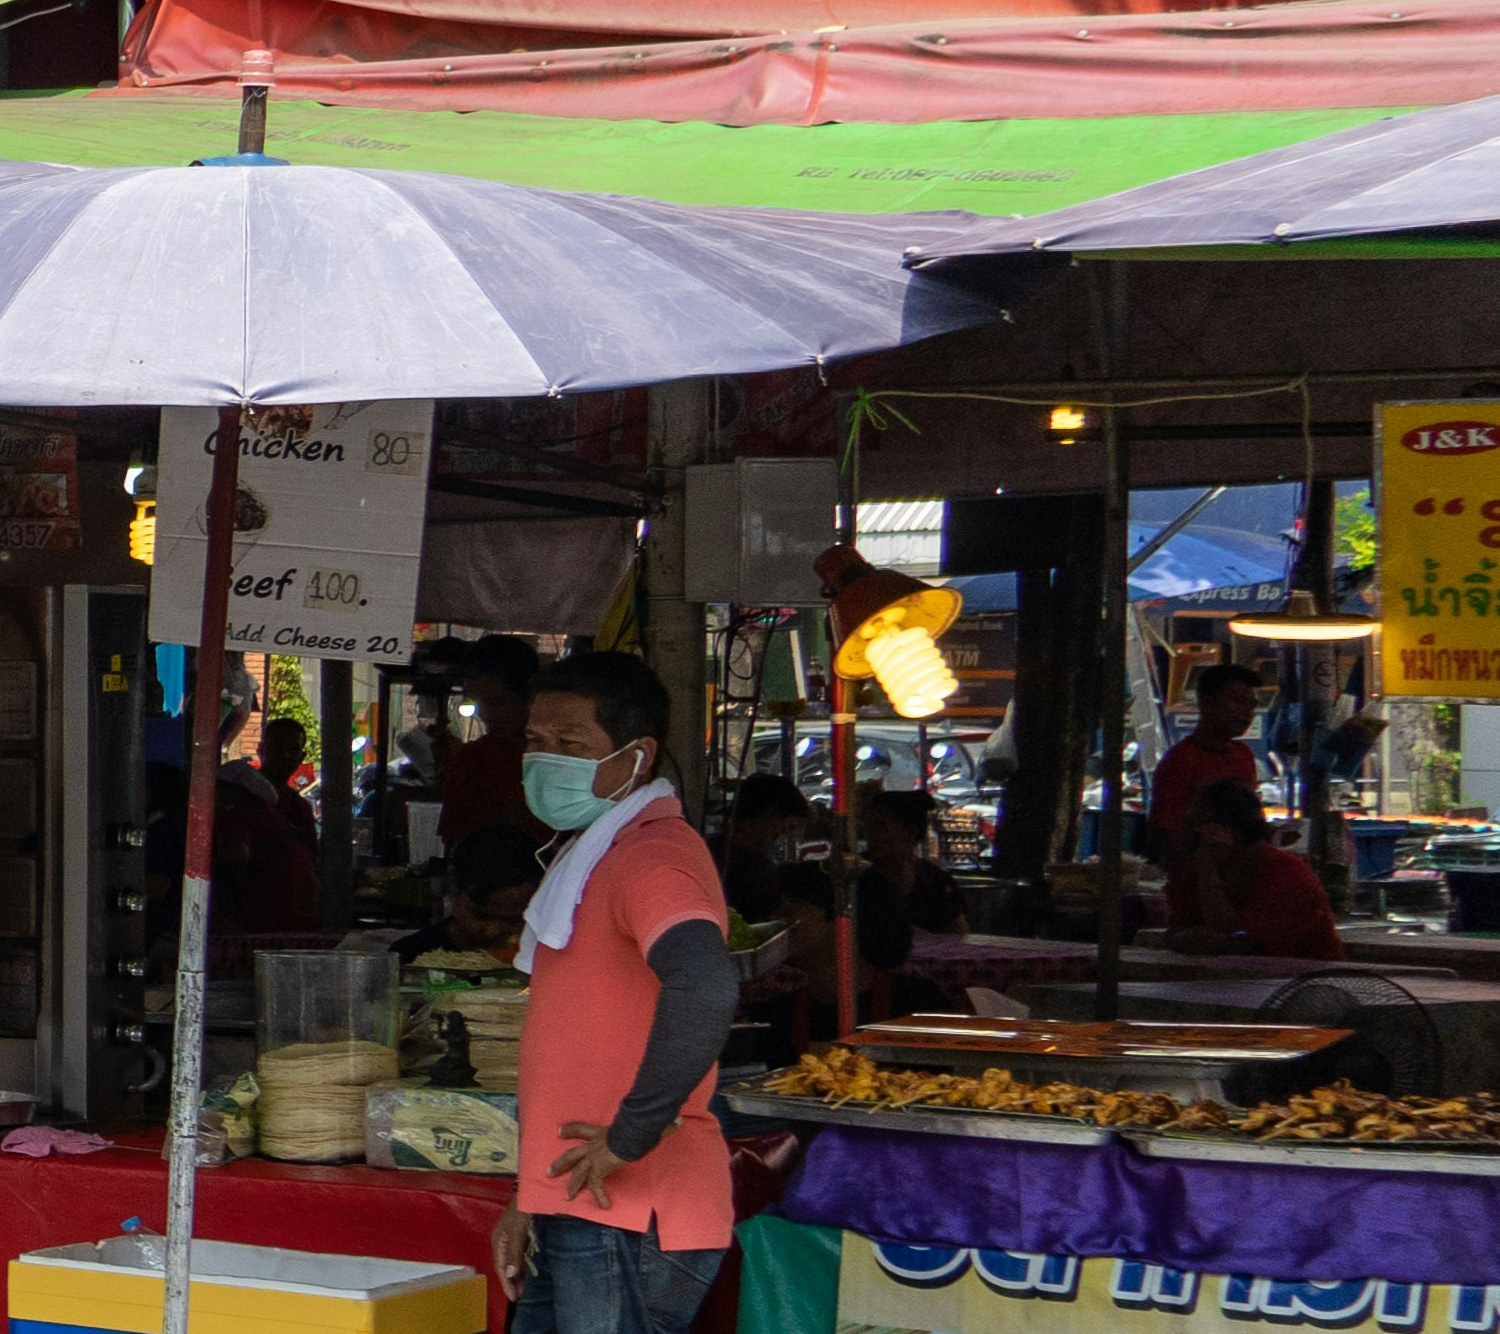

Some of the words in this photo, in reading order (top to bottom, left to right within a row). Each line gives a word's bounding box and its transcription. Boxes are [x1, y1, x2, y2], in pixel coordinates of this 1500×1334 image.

[1413, 427, 1497, 450] J&K
[228, 569, 297, 602] eef
[1257, 584, 1279, 601] Ba
[1401, 557, 1500, 617] น้ำจิ้
[274, 628, 356, 653] Cheese
[367, 635, 404, 657] 20.
